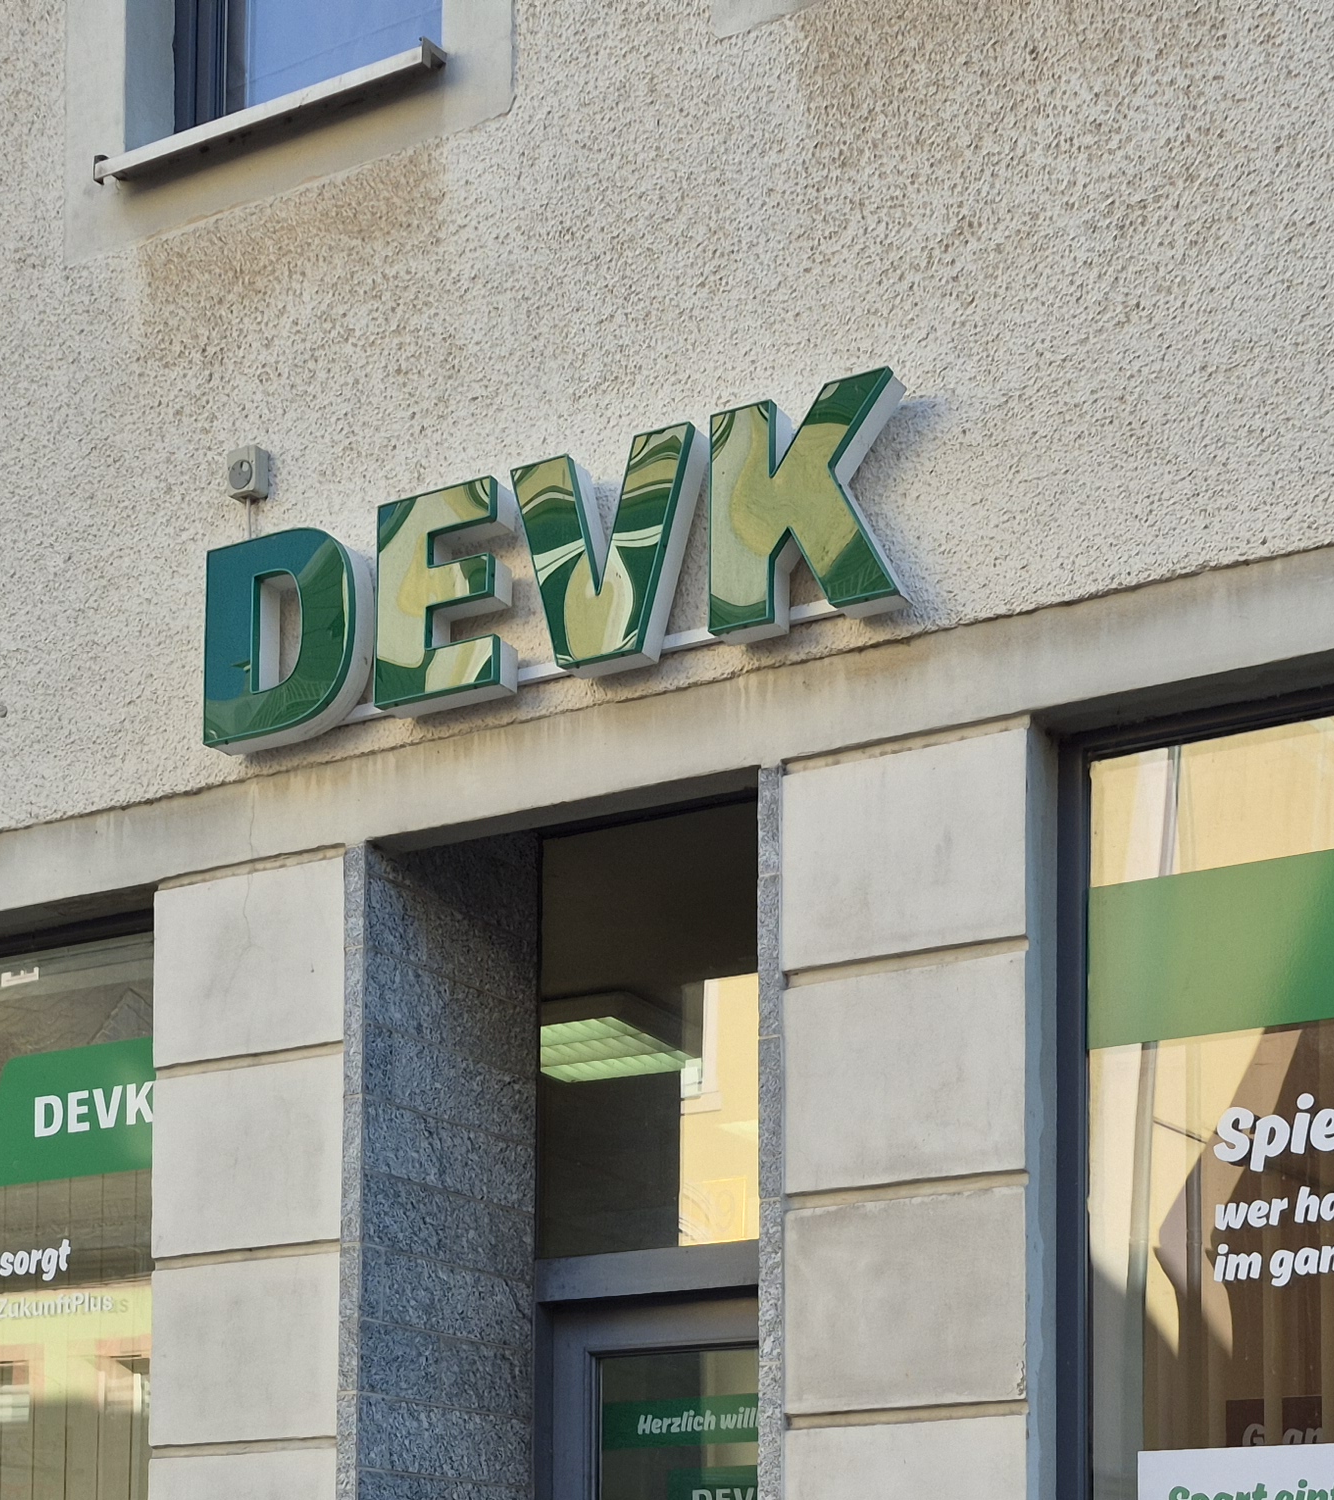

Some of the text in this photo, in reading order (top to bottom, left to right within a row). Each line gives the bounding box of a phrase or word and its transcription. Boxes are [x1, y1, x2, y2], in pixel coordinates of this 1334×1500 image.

[203, 365, 912, 756] DEVK
[34, 1081, 153, 1138] DEVK
[1213, 1193, 1289, 1232] wer
[1213, 1243, 1262, 1283] im
[637, 1409, 716, 1435] Herzlich
